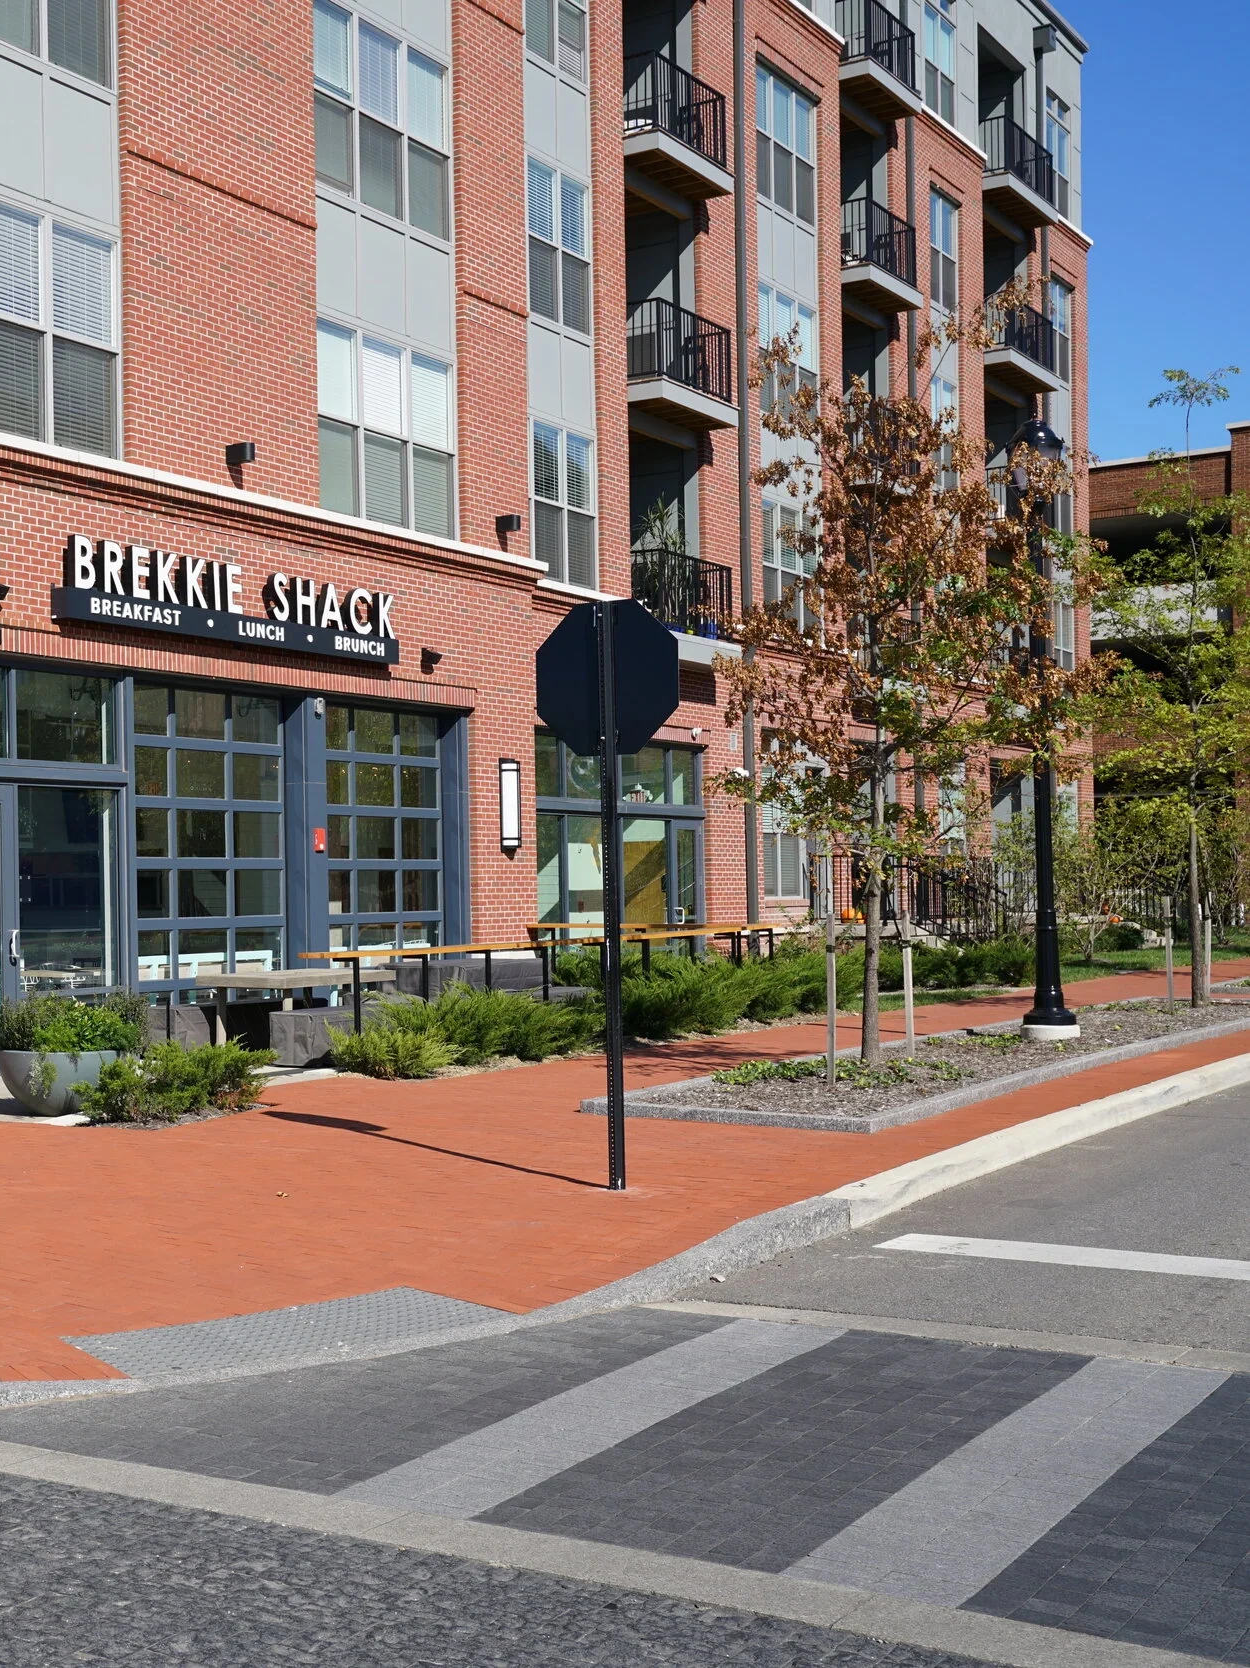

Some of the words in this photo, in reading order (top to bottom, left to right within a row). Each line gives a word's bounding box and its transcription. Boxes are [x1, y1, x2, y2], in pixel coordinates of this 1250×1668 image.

[73, 534, 244, 614] BREKKIE
[272, 572, 396, 639] SHACK
[90, 597, 182, 626] BREAKFAST
[238, 621, 285, 642] LUNCH
[334, 635, 385, 657] BRUNCH
